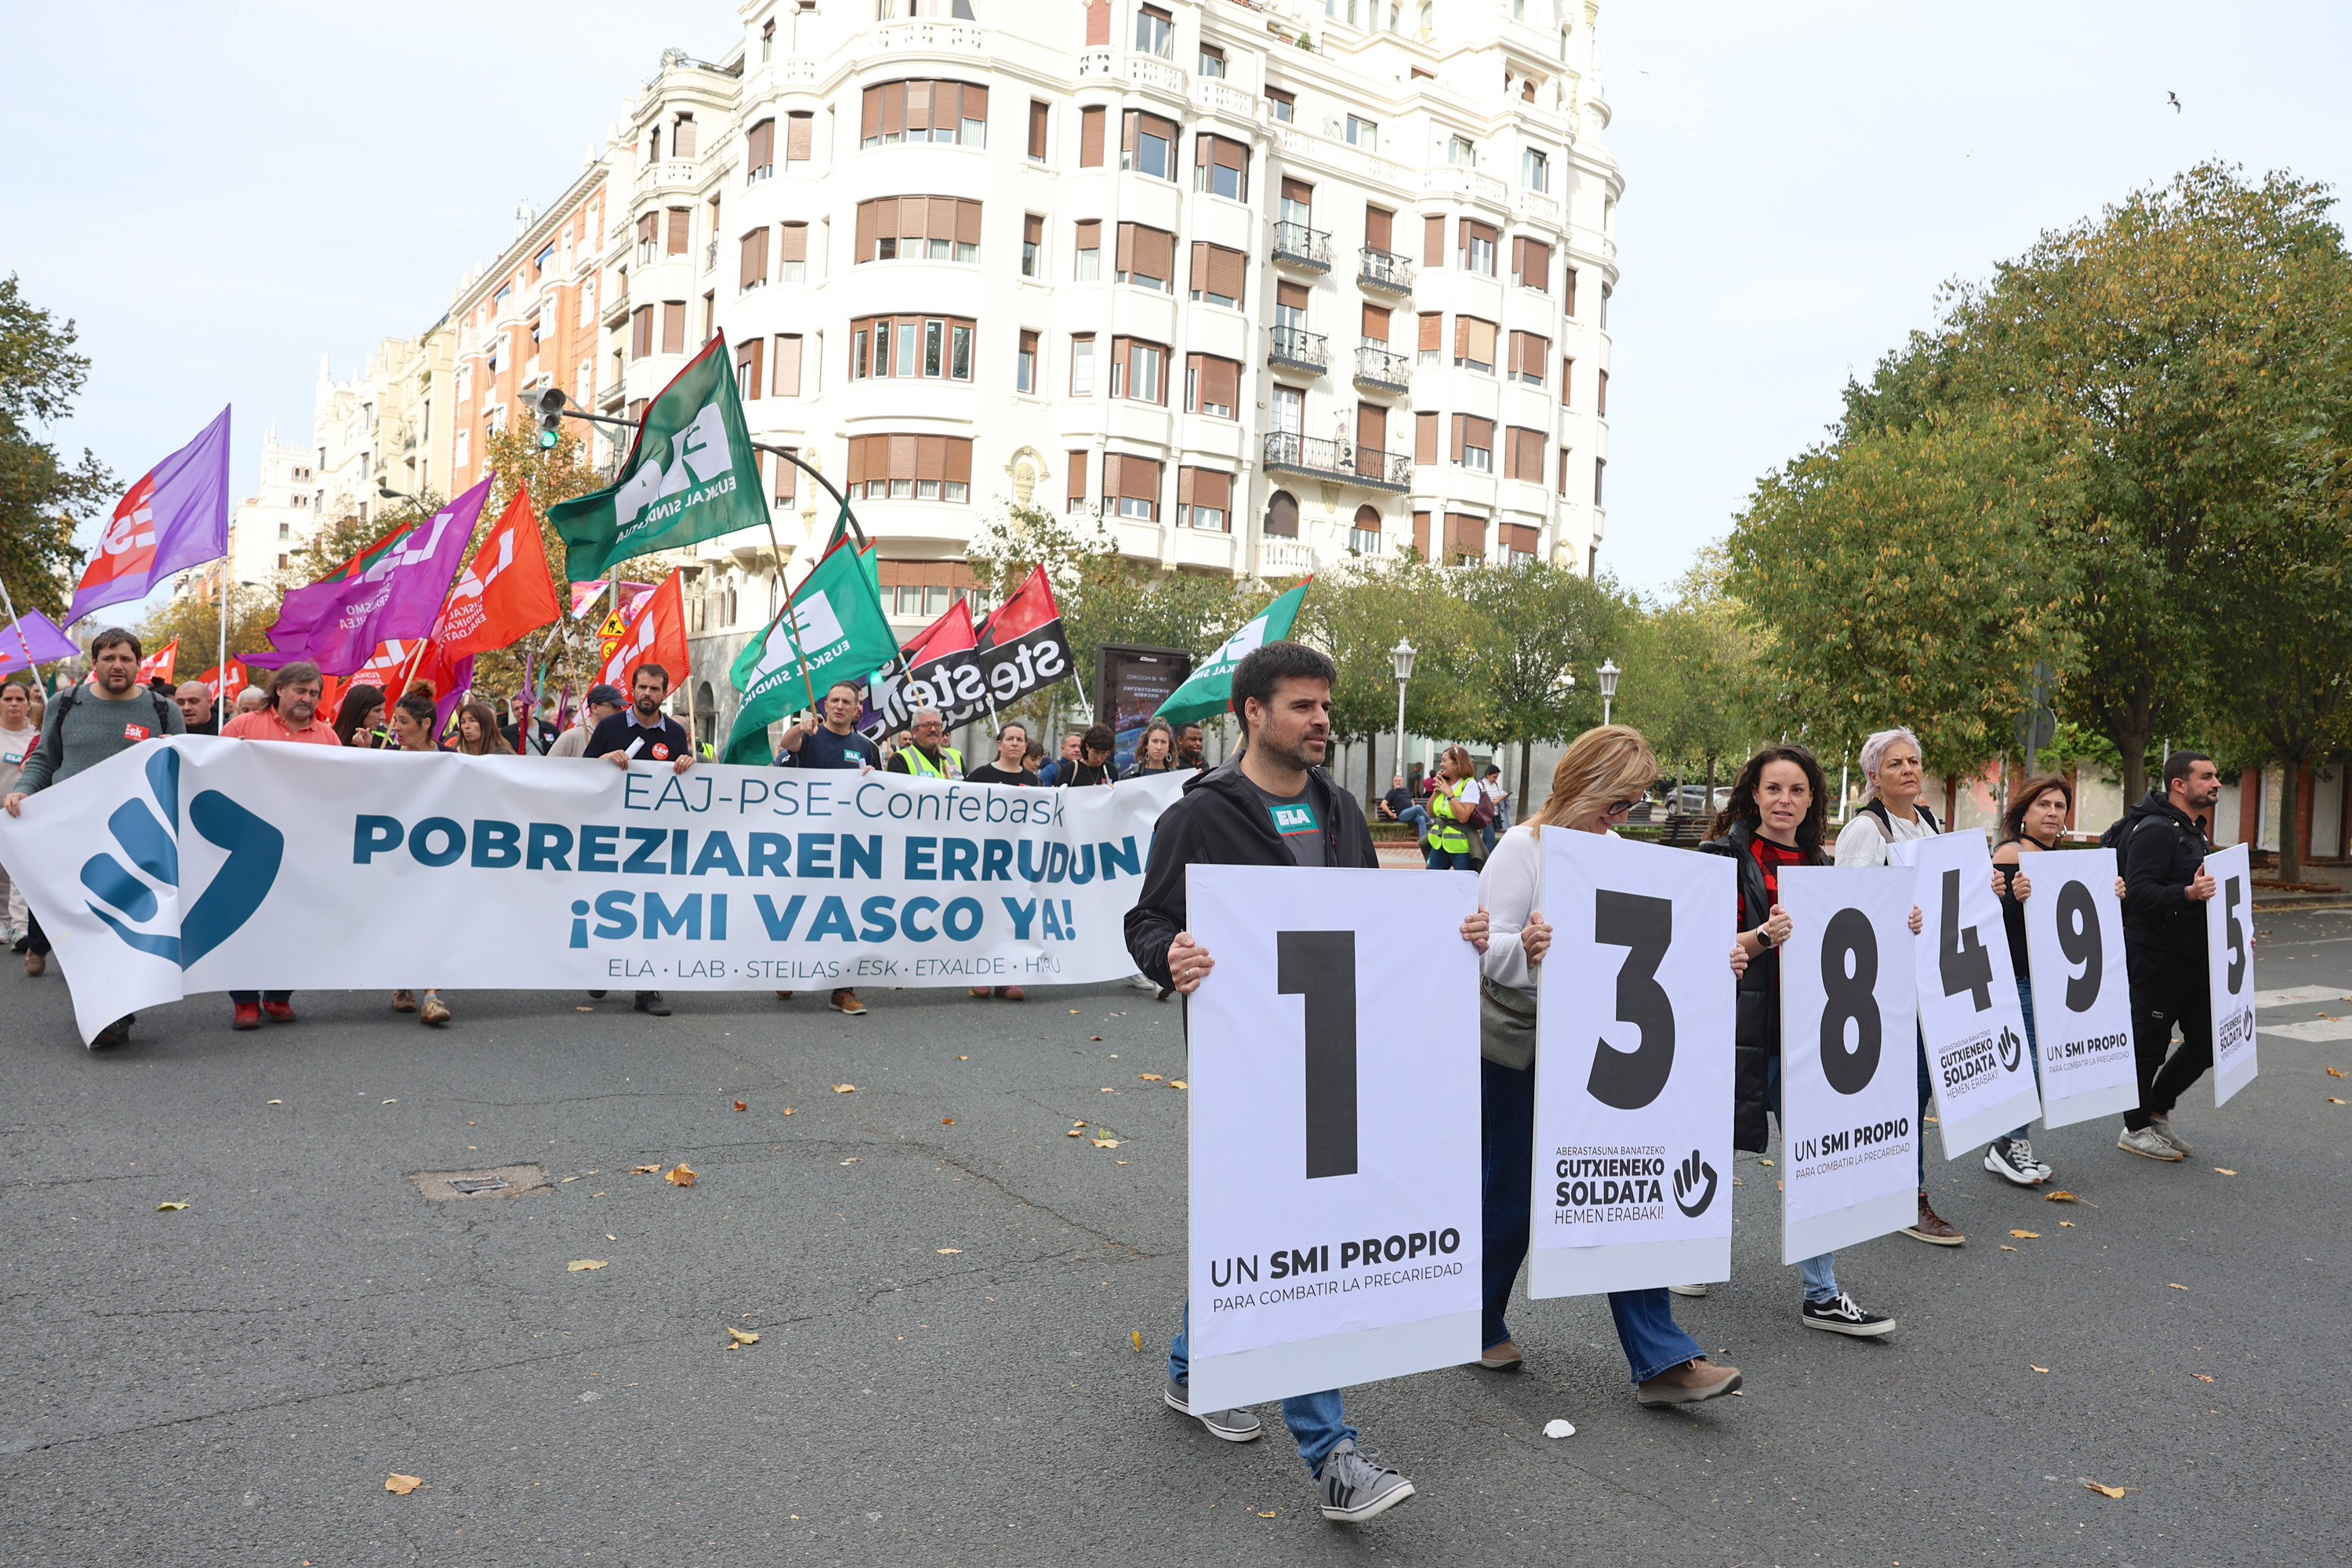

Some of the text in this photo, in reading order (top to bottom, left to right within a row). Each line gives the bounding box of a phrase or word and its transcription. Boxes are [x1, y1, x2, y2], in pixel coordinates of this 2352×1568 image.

[846, 751, 859, 760] ELA
[624, 772, 1065, 827] EAJ-PSE-Confebask
[1276, 808, 1311, 826] ELA
[353, 814, 1156, 885] POBREZIAREN ERRUDUN
[753, 895, 984, 942] VASCO
[1000, 896, 1076, 941] YA!
[2225, 875, 2246, 996] 5
[1939, 869, 1993, 1013] 4
[2056, 880, 2103, 1013] 9
[608, 956, 1061, 978] ELA LAB STEILAS ESK ETXALDE HIRU
[1586, 888, 1676, 1110] 3
[1820, 907, 1882, 1095] 8
[1277, 931, 1358, 1179] 1
[1940, 1038, 1993, 1069] GUTXIENEKO
[2046, 1033, 2127, 1061] UN SMI PROPIO
[2220, 1025, 2242, 1052] SOLDATA
[1944, 1053, 1997, 1088] SOLDATA
[2049, 1051, 2129, 1074] PARA COMBATIR LA PRECARIEDAD
[1946, 1069, 2000, 1101] HEMEN ERABAKI!
[1555, 1145, 1666, 1156] ABERASTASUNA BANATZEKO
[1795, 1117, 1909, 1162] UN SMI PROPIO
[1556, 1158, 1665, 1178] GUTXIENEKO
[1796, 1142, 1911, 1181] PARA COMBATIR LA PRECARIEDAD
[1555, 1179, 1664, 1207] SOLDATA
[1555, 1206, 1664, 1225] HEMEN ERABAKI!
[1211, 1227, 1461, 1287] UN SMI PROPIO
[1213, 1261, 1463, 1312] PARA COMBATIR LA PRECARIEDAD
